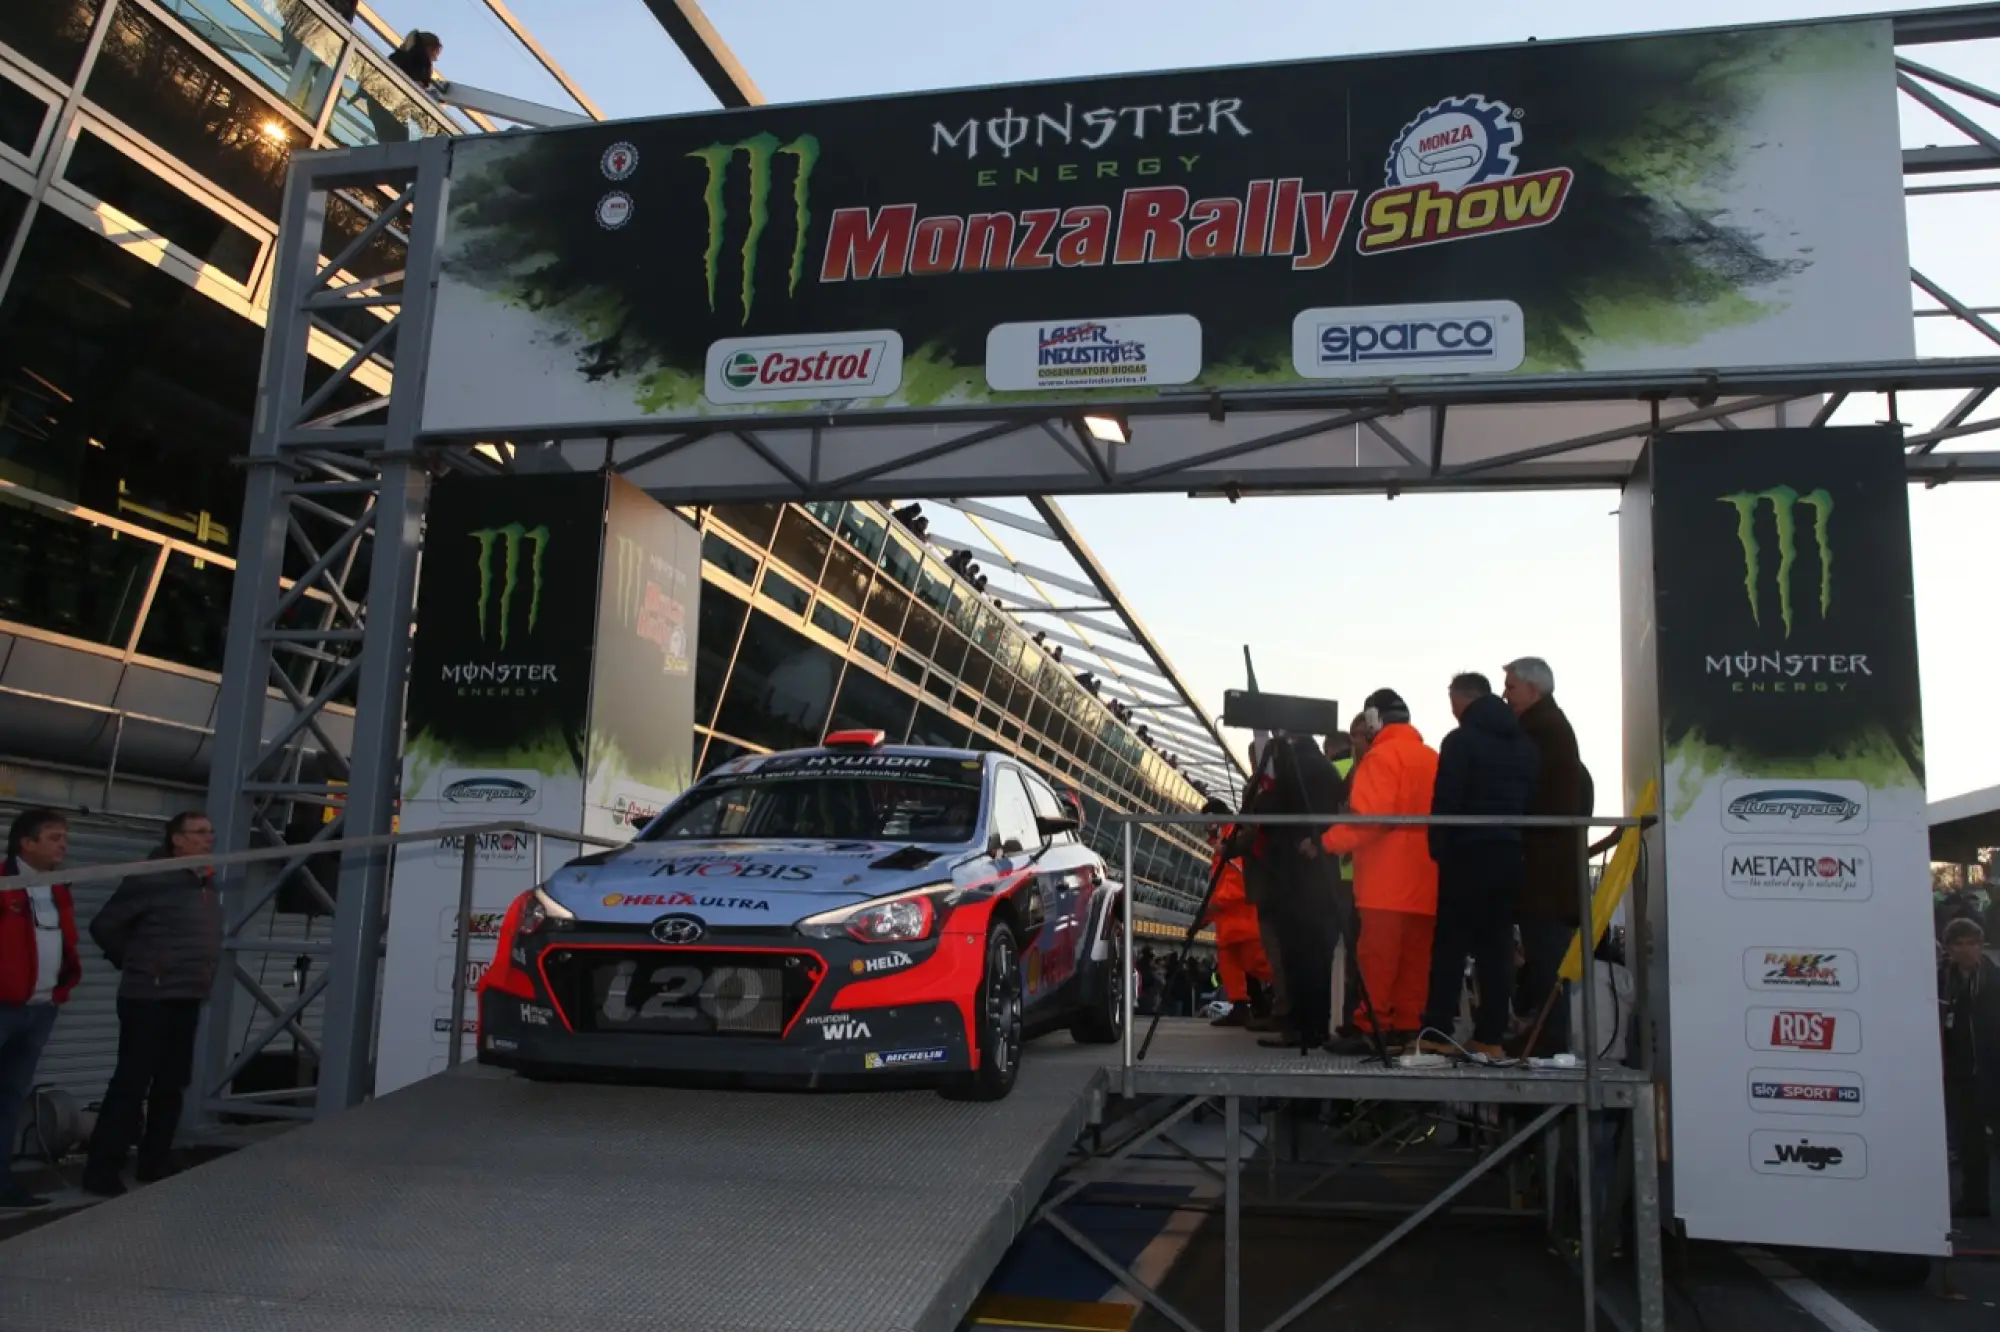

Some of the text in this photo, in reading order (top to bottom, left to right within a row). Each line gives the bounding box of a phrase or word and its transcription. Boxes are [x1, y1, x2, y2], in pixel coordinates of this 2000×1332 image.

[931, 97, 1252, 159] MONSTER
[1419, 125, 1473, 153] MONZA
[977, 155, 1200, 187] ENERGY
[1365, 177, 1562, 247] Show
[1038, 323, 1113, 346] LASER
[1321, 321, 1493, 362] sparco
[761, 348, 872, 384] Castrol
[441, 661, 558, 684] MONSTER
[1705, 650, 1872, 679] MONSTER
[457, 687, 540, 697] ENERGY
[1732, 681, 1848, 692] ENERGY
[806, 756, 931, 768] HYUNDAI
[650, 862, 818, 881] MOBIS
[1731, 855, 1857, 877] METATRON
[623, 891, 770, 911] HELIX ULTRA
[866, 951, 913, 972] HELIX
[806, 1014, 850, 1025] HYUNDAI
[1780, 1013, 1824, 1041] RDS
[886, 1050, 943, 1063] MICHELIN
[1783, 1086, 1833, 1099] SPORT
[1838, 1089, 1857, 1100] HD
